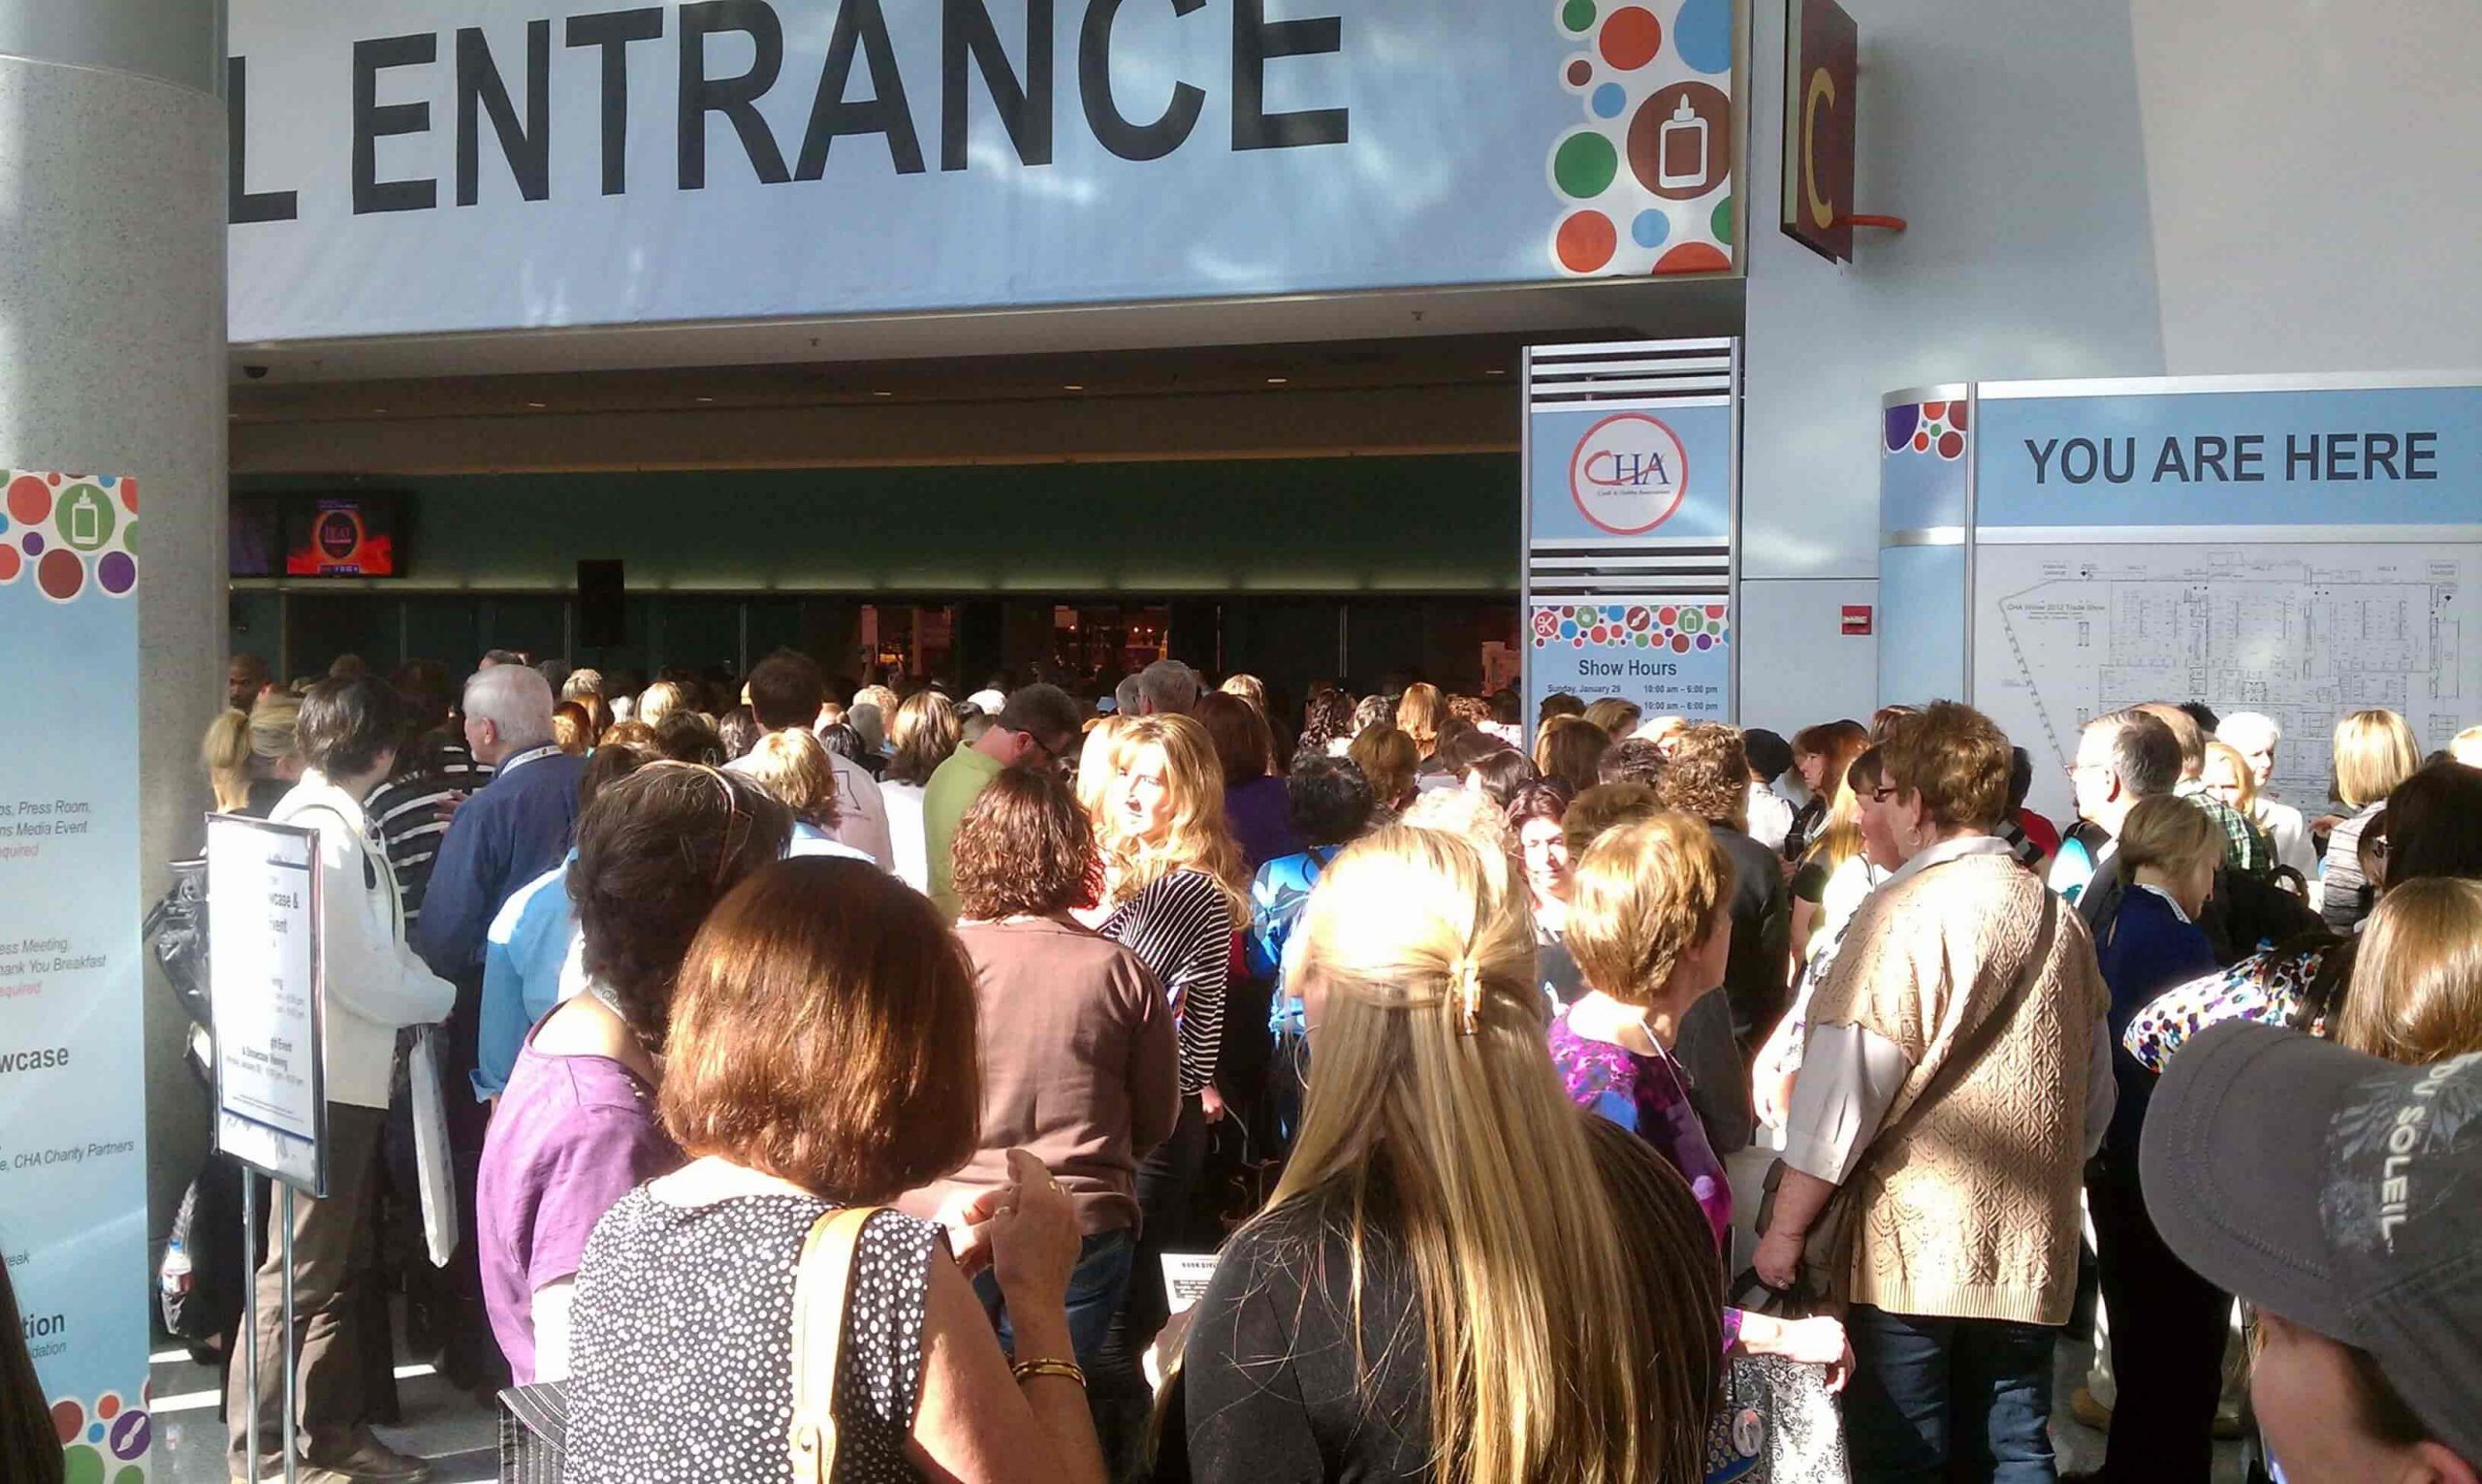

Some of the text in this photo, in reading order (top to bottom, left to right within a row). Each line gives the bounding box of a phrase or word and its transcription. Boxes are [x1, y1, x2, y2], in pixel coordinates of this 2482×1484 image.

[352, 0, 1350, 215] ENTRANCE
[1583, 450, 1671, 486] CHA
[2024, 432, 2437, 485] YOU ARE HERE
[1578, 659, 1677, 677] Show Hours
[1579, 684, 1609, 694] January
[1644, 684, 1665, 694] 10:00
[1644, 701, 1665, 710] 10:00
[18, 801, 52, 815] Press
[16, 821, 51, 837] Media
[54, 820, 87, 835] Event
[29, 960, 50, 974] You
[53, 955, 107, 972] Breakfast
[15, 1151, 42, 1169] CHA
[45, 1148, 84, 1164] Charity
[87, 1141, 135, 1156] Partners
[2381, 1106, 2426, 1241] SOLEIL
[23, 1312, 65, 1340] tion
